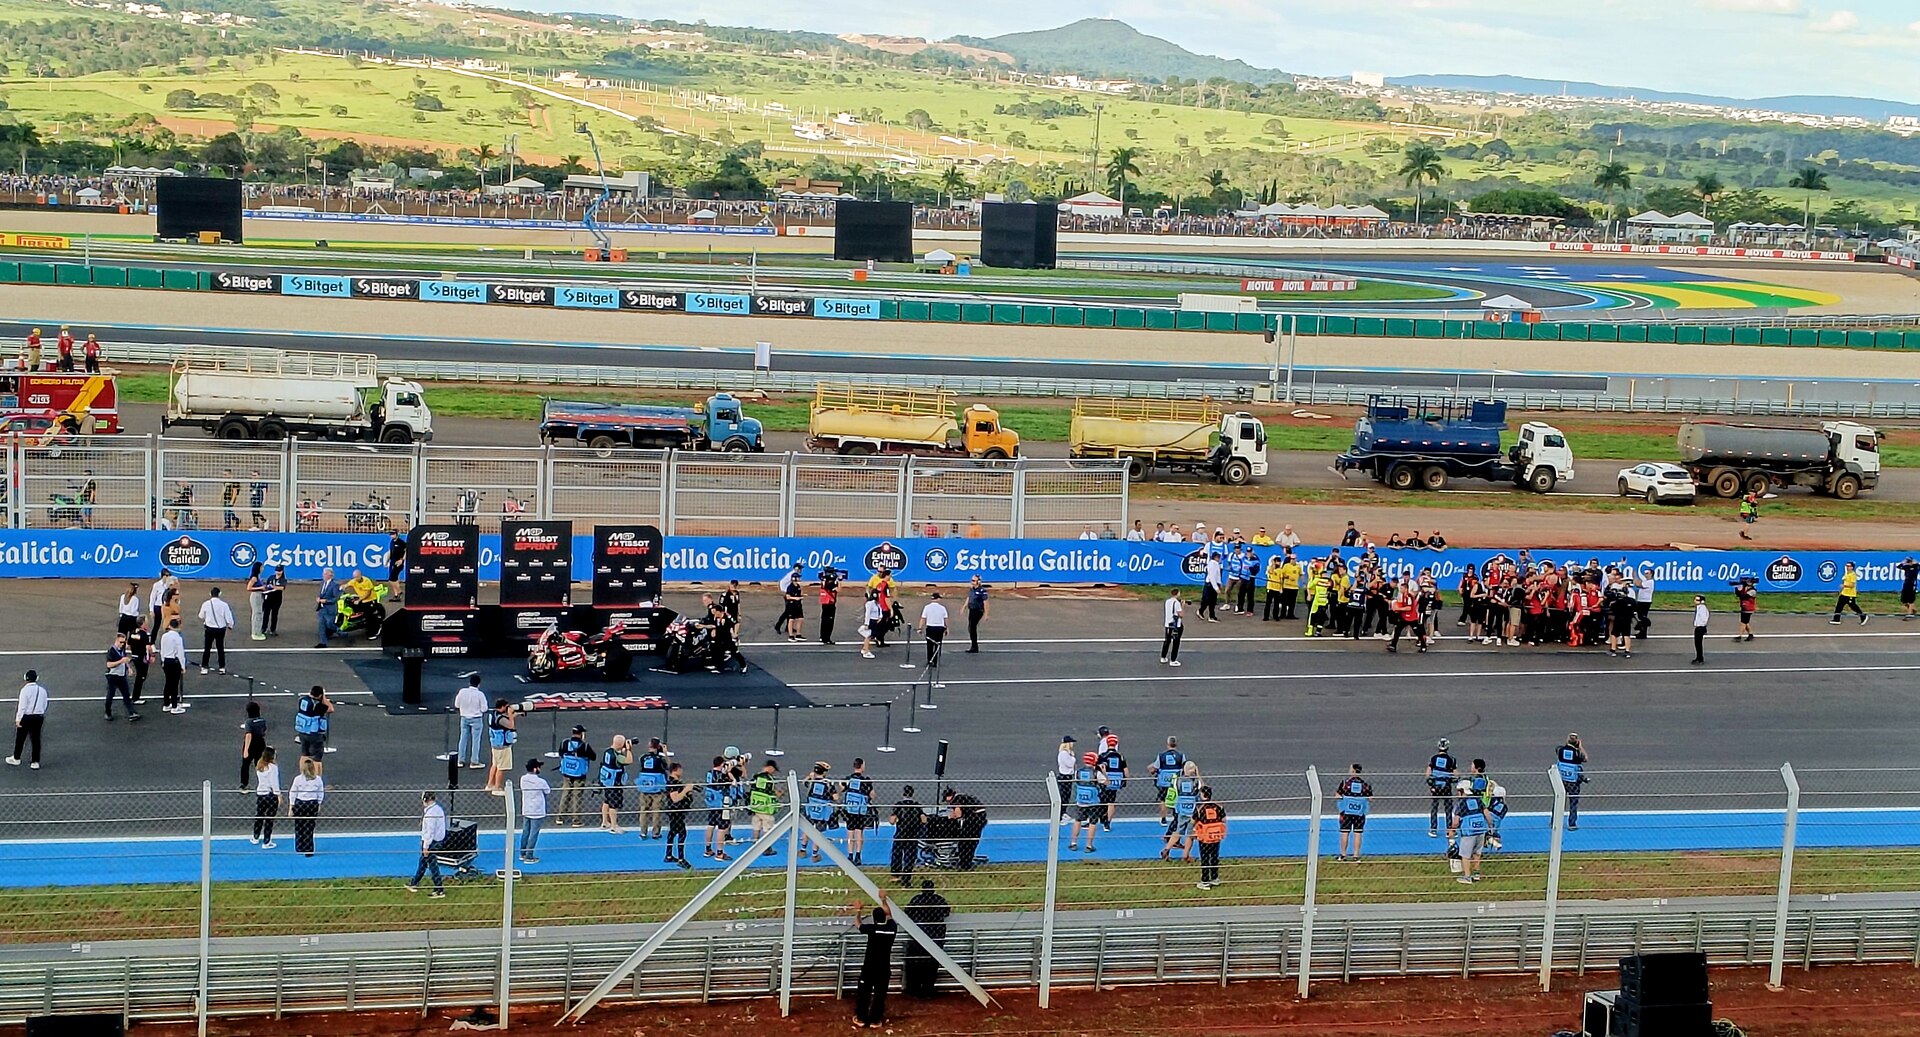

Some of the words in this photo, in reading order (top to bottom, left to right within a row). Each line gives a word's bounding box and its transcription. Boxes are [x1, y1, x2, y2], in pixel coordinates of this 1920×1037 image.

[16, 235, 63, 248] PIRELLI
[232, 276, 272, 290] Bitget
[304, 280, 343, 293] Bitget
[372, 282, 410, 296] Bitget
[1246, 281, 1274, 291] MOTUL
[1282, 281, 1304, 291] MOTUL
[442, 286, 480, 299] Bitget
[508, 288, 546, 303] Bitget
[576, 292, 614, 306] Bitget
[639, 294, 676, 307] Bitget
[707, 298, 744, 311] Bitget
[769, 299, 806, 314] Bitget
[835, 303, 871, 316] Bitget
[94, 544, 124, 564] 0,0
[168, 546, 201, 555] Estrella
[264, 543, 358, 567] Estrella
[420, 547, 464, 555] SPRINT
[607, 547, 649, 555] SPRINT
[872, 552, 900, 560] Estrella
[169, 555, 200, 564] Galicia
[662, 548, 709, 569] rella
[713, 546, 791, 569] Galicia
[808, 550, 833, 569] 0,0
[954, 549, 1035, 570] Estrella
[1039, 549, 1111, 571] Galicia
[1128, 554, 1153, 572] 0,0
[1431, 560, 1453, 578] 0,0
[1717, 563, 1740, 580] 0,0
[1772, 564, 1797, 572] Estrella
[1772, 572, 1795, 580] Galicia
